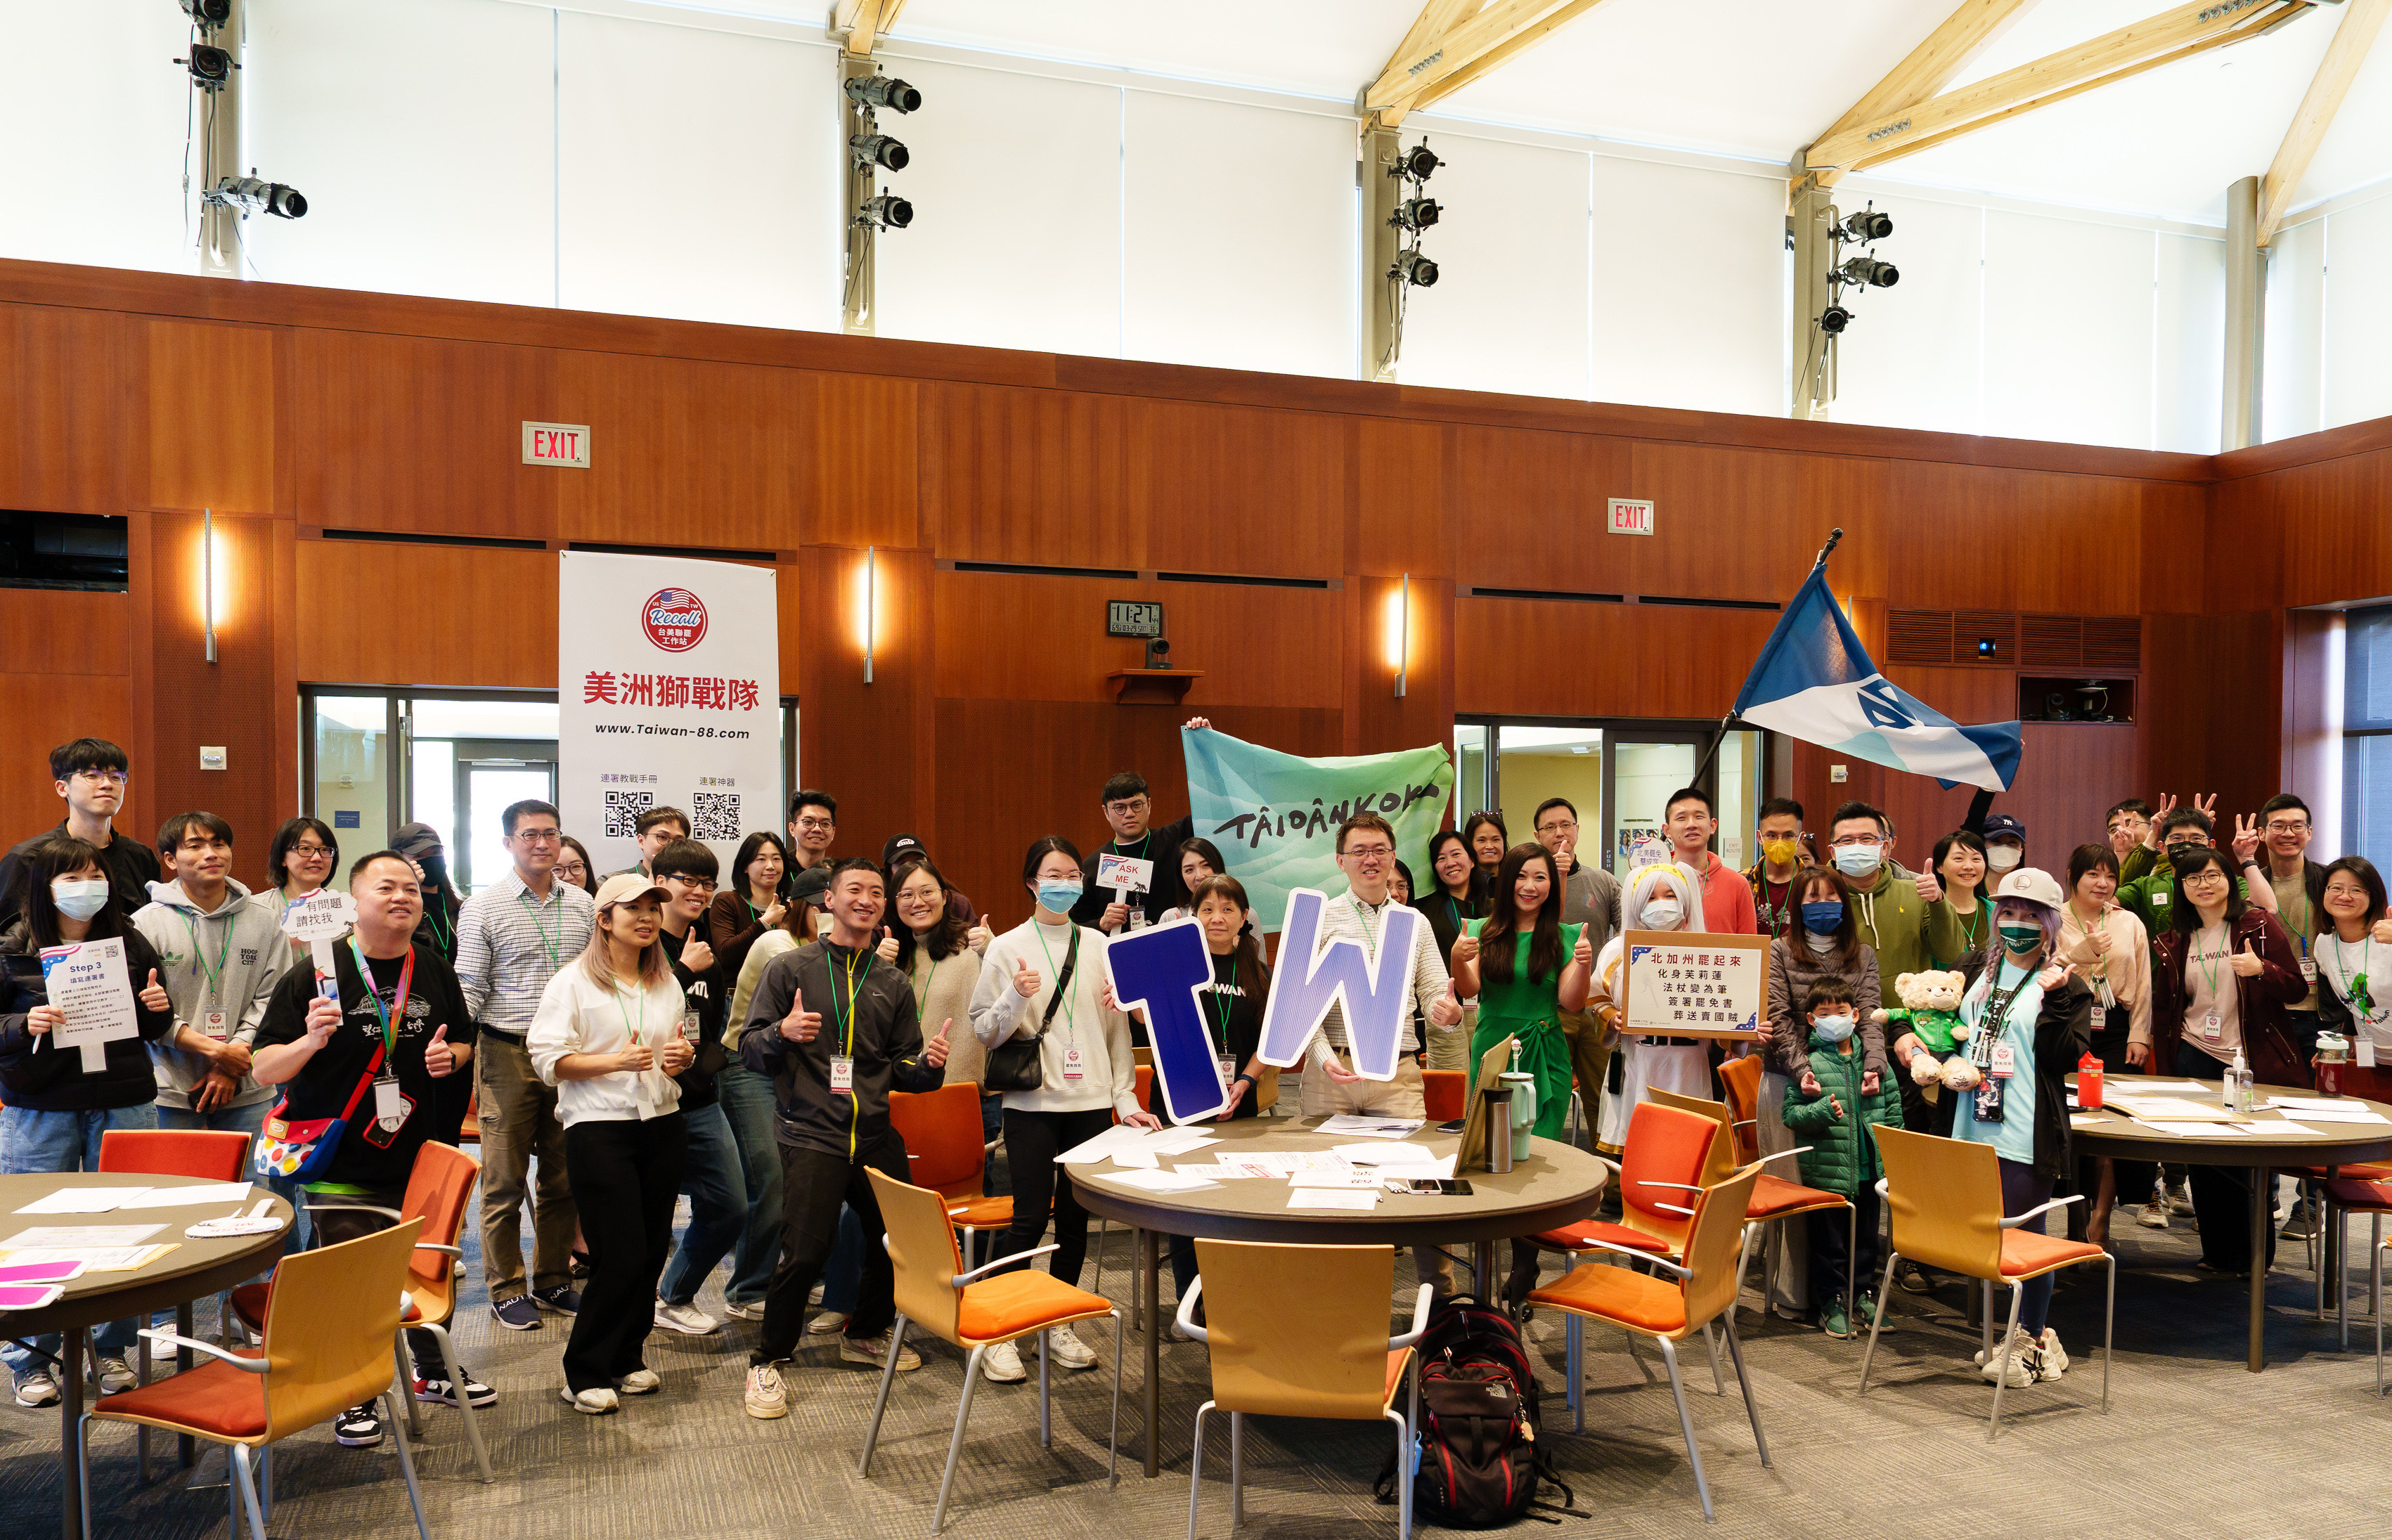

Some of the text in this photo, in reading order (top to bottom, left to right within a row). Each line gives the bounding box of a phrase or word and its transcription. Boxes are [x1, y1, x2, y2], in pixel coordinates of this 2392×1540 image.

[534, 430, 578, 460] EXIT
[1615, 505, 1646, 529] EXIT
[651, 609, 700, 626] Recall
[1116, 604, 1152, 623] 11:27
[658, 628, 692, 638] 台美聯罷
[661, 637, 687, 645] 工作站
[583, 671, 760, 711] 美洲獅戰隊
[595, 723, 750, 739] www.Taiwan-88.com
[600, 773, 658, 784] 連署教戰手冊
[699, 777, 735, 787] 連署神器
[1119, 865, 1139, 874] ASK
[1115, 874, 1130, 884] ME
[306, 897, 342, 912] 有問題
[296, 912, 333, 928] 請找我
[1650, 952, 1742, 967] 北加州罷起來
[70, 964, 93, 973] Step
[1657, 969, 1722, 981] 化身芙莉蓮
[70, 973, 105, 984] 填寫連署書
[1663, 982, 1727, 995] 法杖變為筆
[1108, 892, 1416, 1119] T W
[1668, 996, 1733, 1009] 簽署罷免書
[1673, 1010, 1738, 1023] 葬送賣國賊
